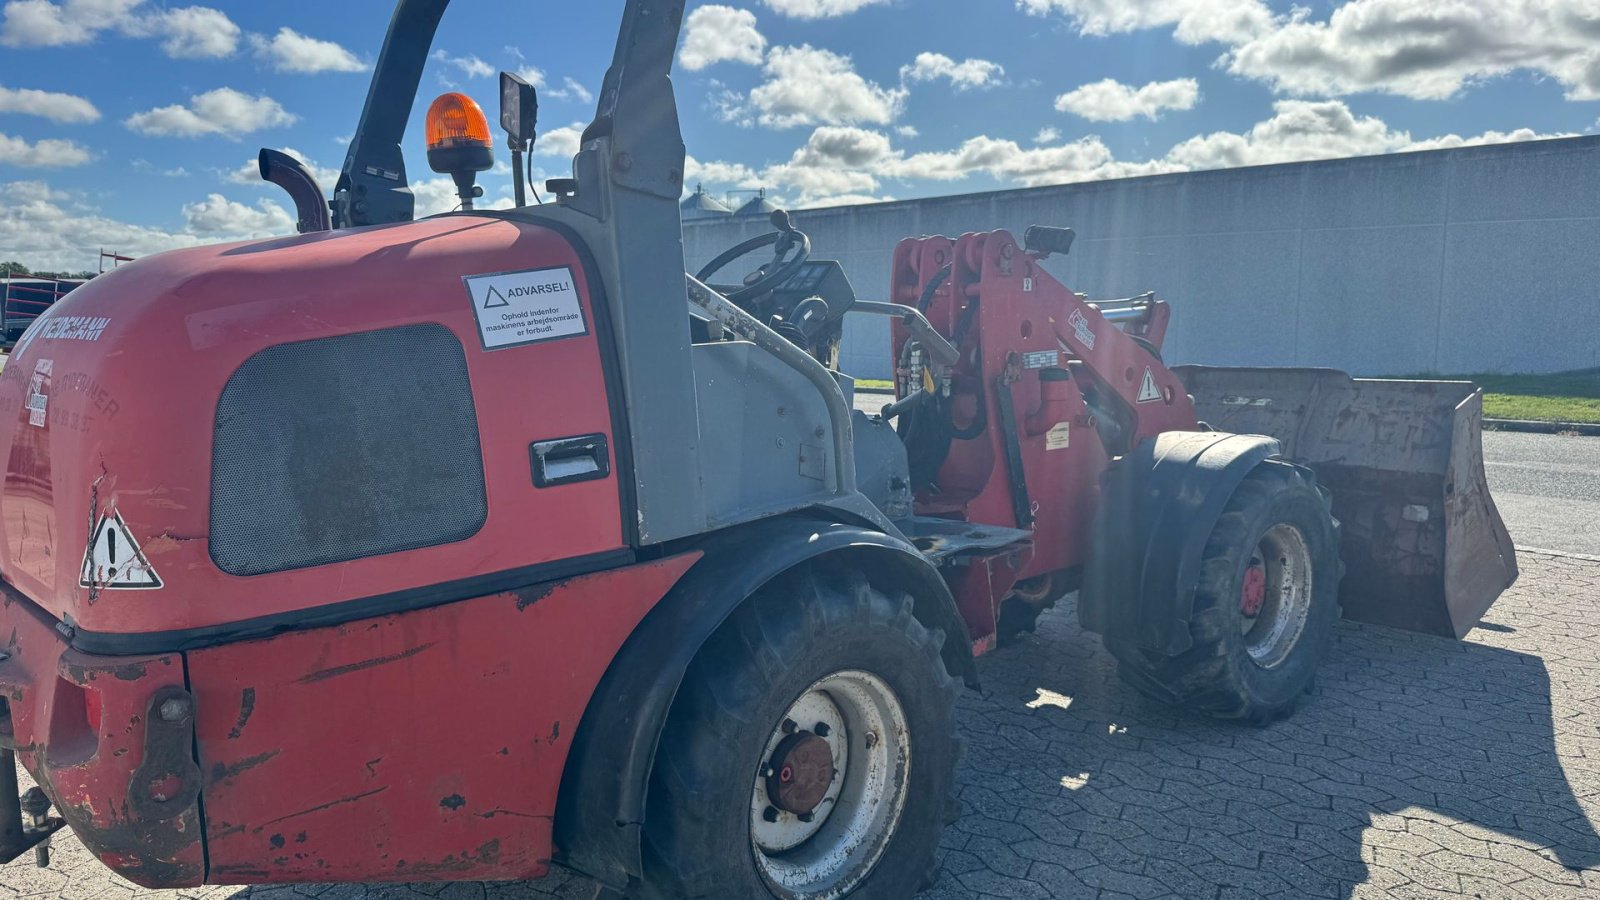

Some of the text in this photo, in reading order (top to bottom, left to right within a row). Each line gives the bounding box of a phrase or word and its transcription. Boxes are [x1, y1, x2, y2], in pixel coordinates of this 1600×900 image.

[508, 281, 569, 298] ADVARSEL!
[486, 313, 579, 332] maskinens arbejdsområde
[501, 307, 560, 322] Ophold indenfor
[516, 325, 555, 337] er forbudt.
